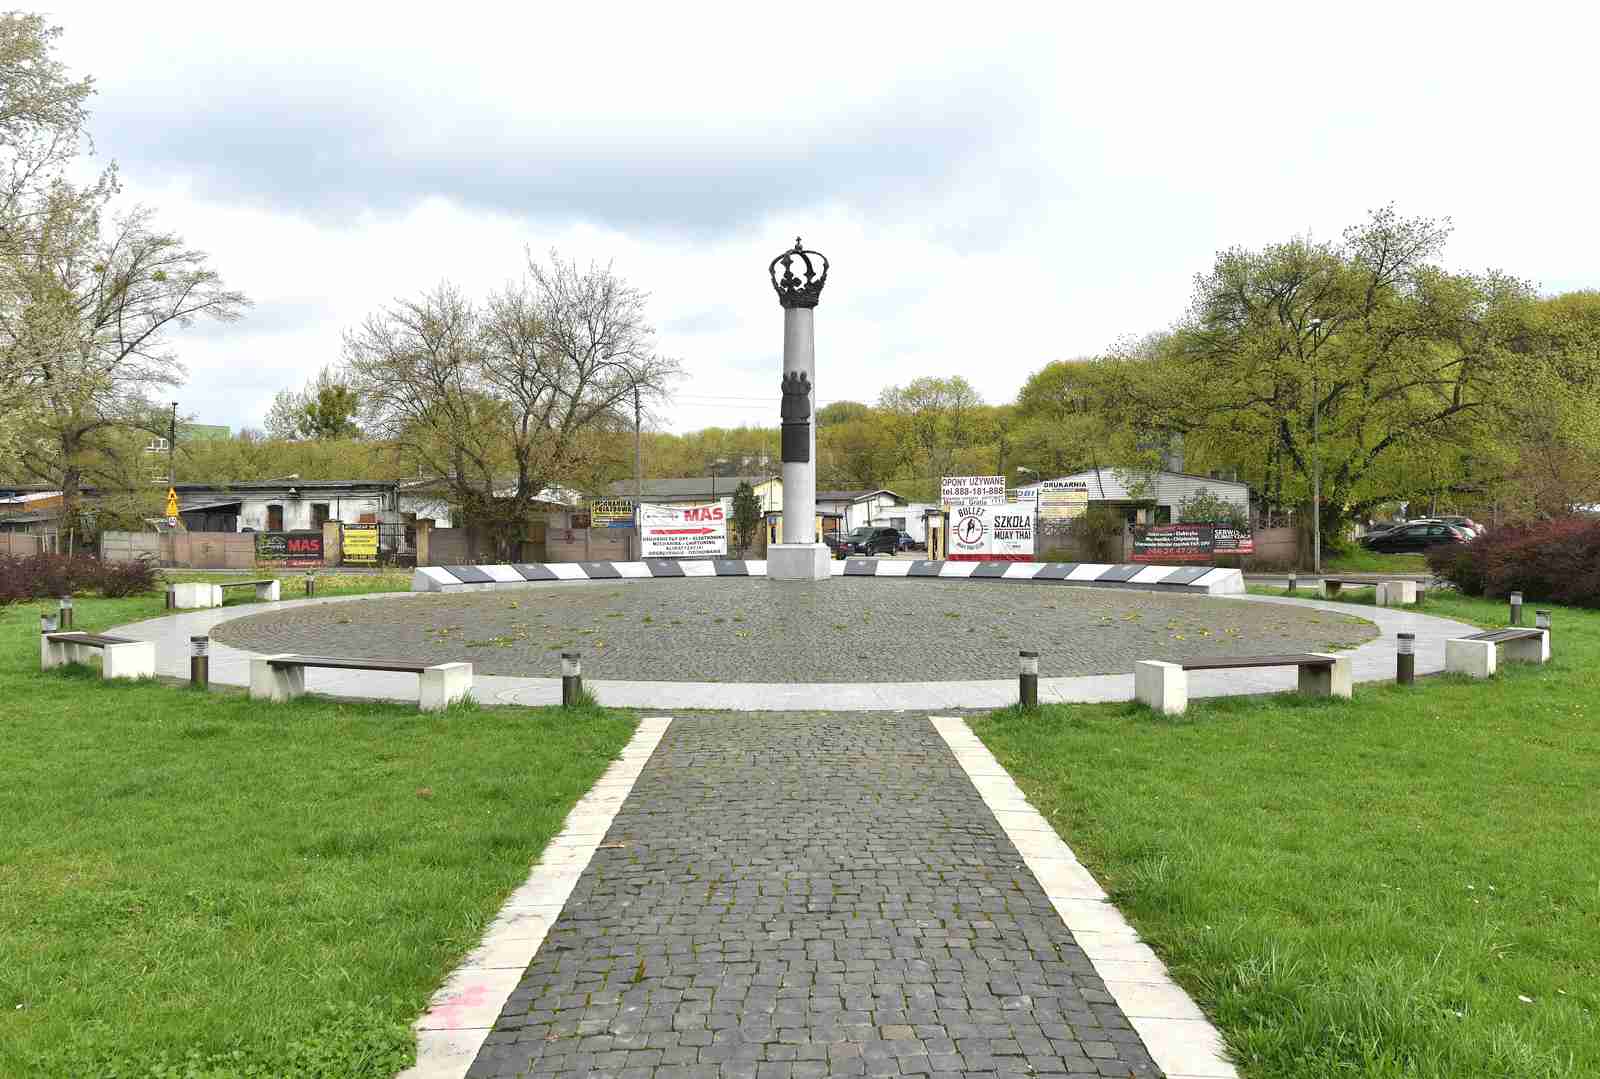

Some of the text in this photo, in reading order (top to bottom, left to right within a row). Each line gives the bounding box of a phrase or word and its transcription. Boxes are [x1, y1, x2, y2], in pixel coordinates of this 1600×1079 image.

[942, 476, 1004, 487] OPONY UŻYWANE
[942, 487, 1004, 496] tel.888-181-888
[684, 507, 724, 521] MAS
[958, 505, 986, 518] BULLET
[994, 515, 1031, 528] SZKOŁA
[994, 530, 1031, 540] MUAY THAI
[287, 539, 320, 552] MAS
